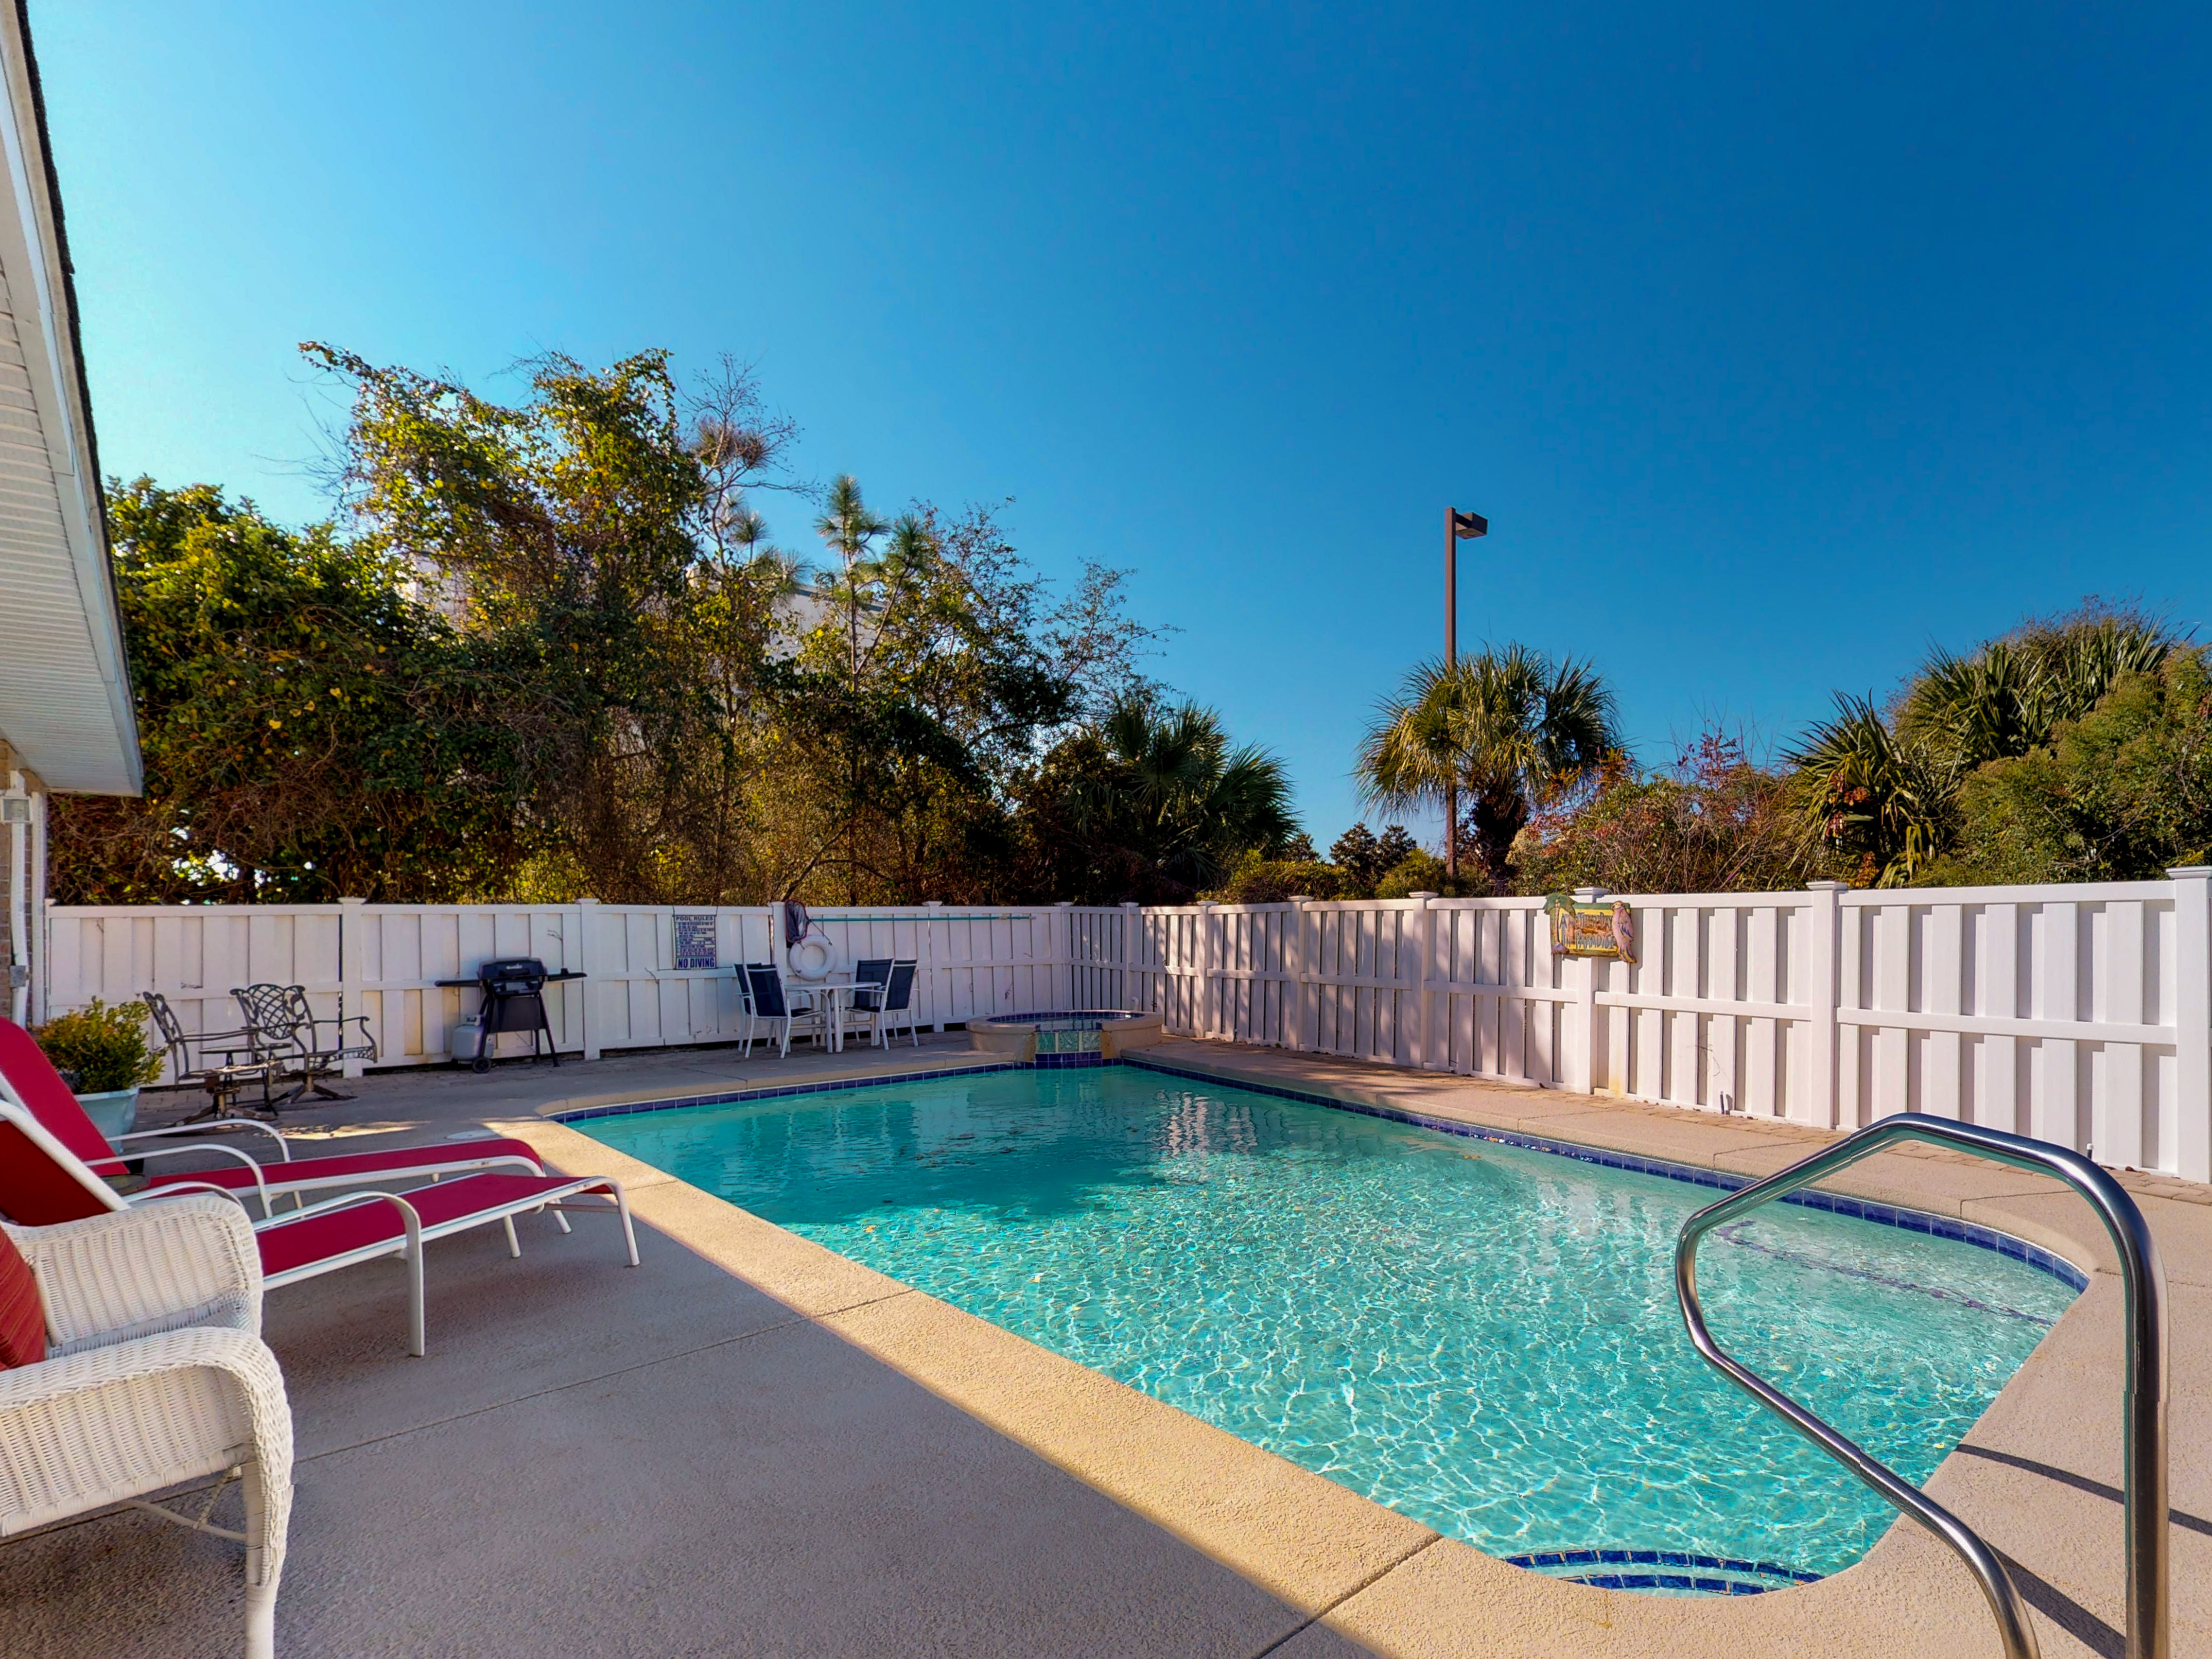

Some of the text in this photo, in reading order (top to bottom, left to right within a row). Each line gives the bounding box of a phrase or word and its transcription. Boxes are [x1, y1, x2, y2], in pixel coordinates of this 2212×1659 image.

[1600, 912, 1614, 930] DAY
[678, 958, 714, 968] NO DIVING
